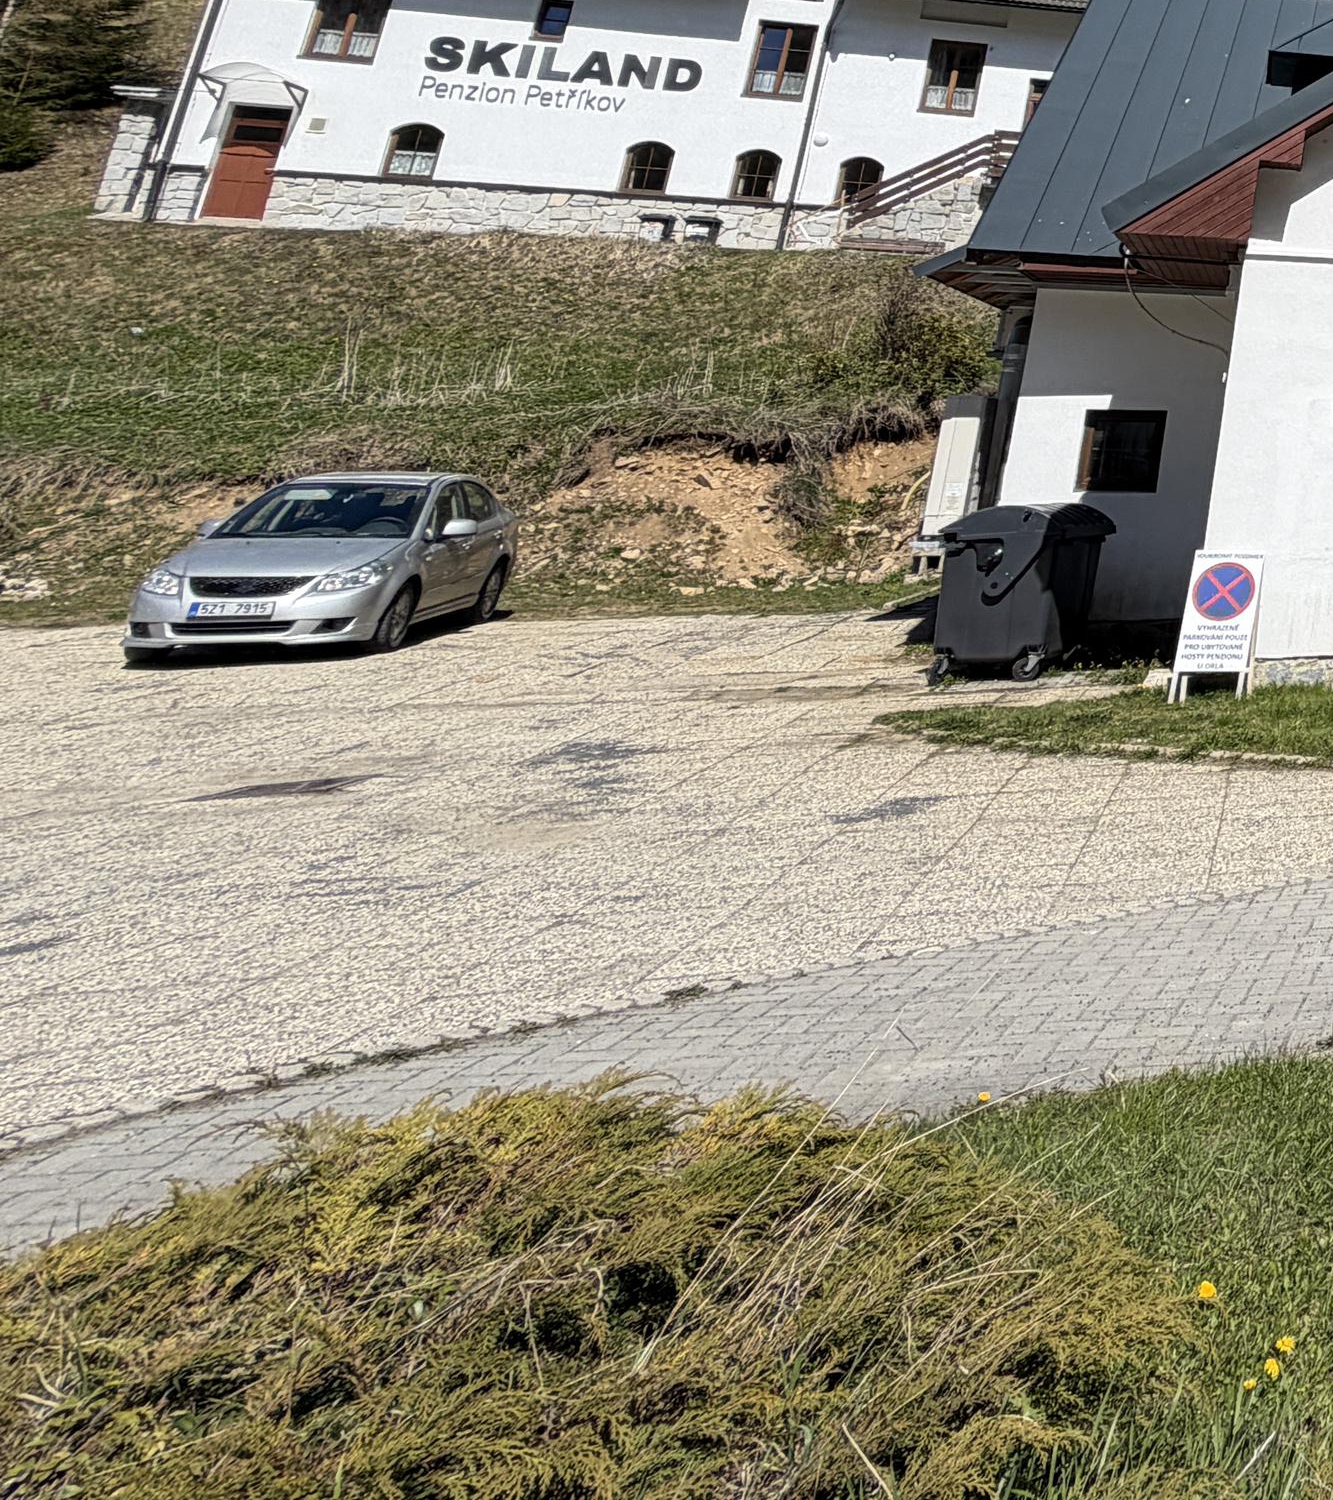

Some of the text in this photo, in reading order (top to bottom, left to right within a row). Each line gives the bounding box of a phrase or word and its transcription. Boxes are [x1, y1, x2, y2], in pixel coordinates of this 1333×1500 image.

[424, 36, 703, 92] SKILAND
[418, 75, 626, 113] Penzion Petříkov
[201, 603, 268, 614] 5Z1 7915
